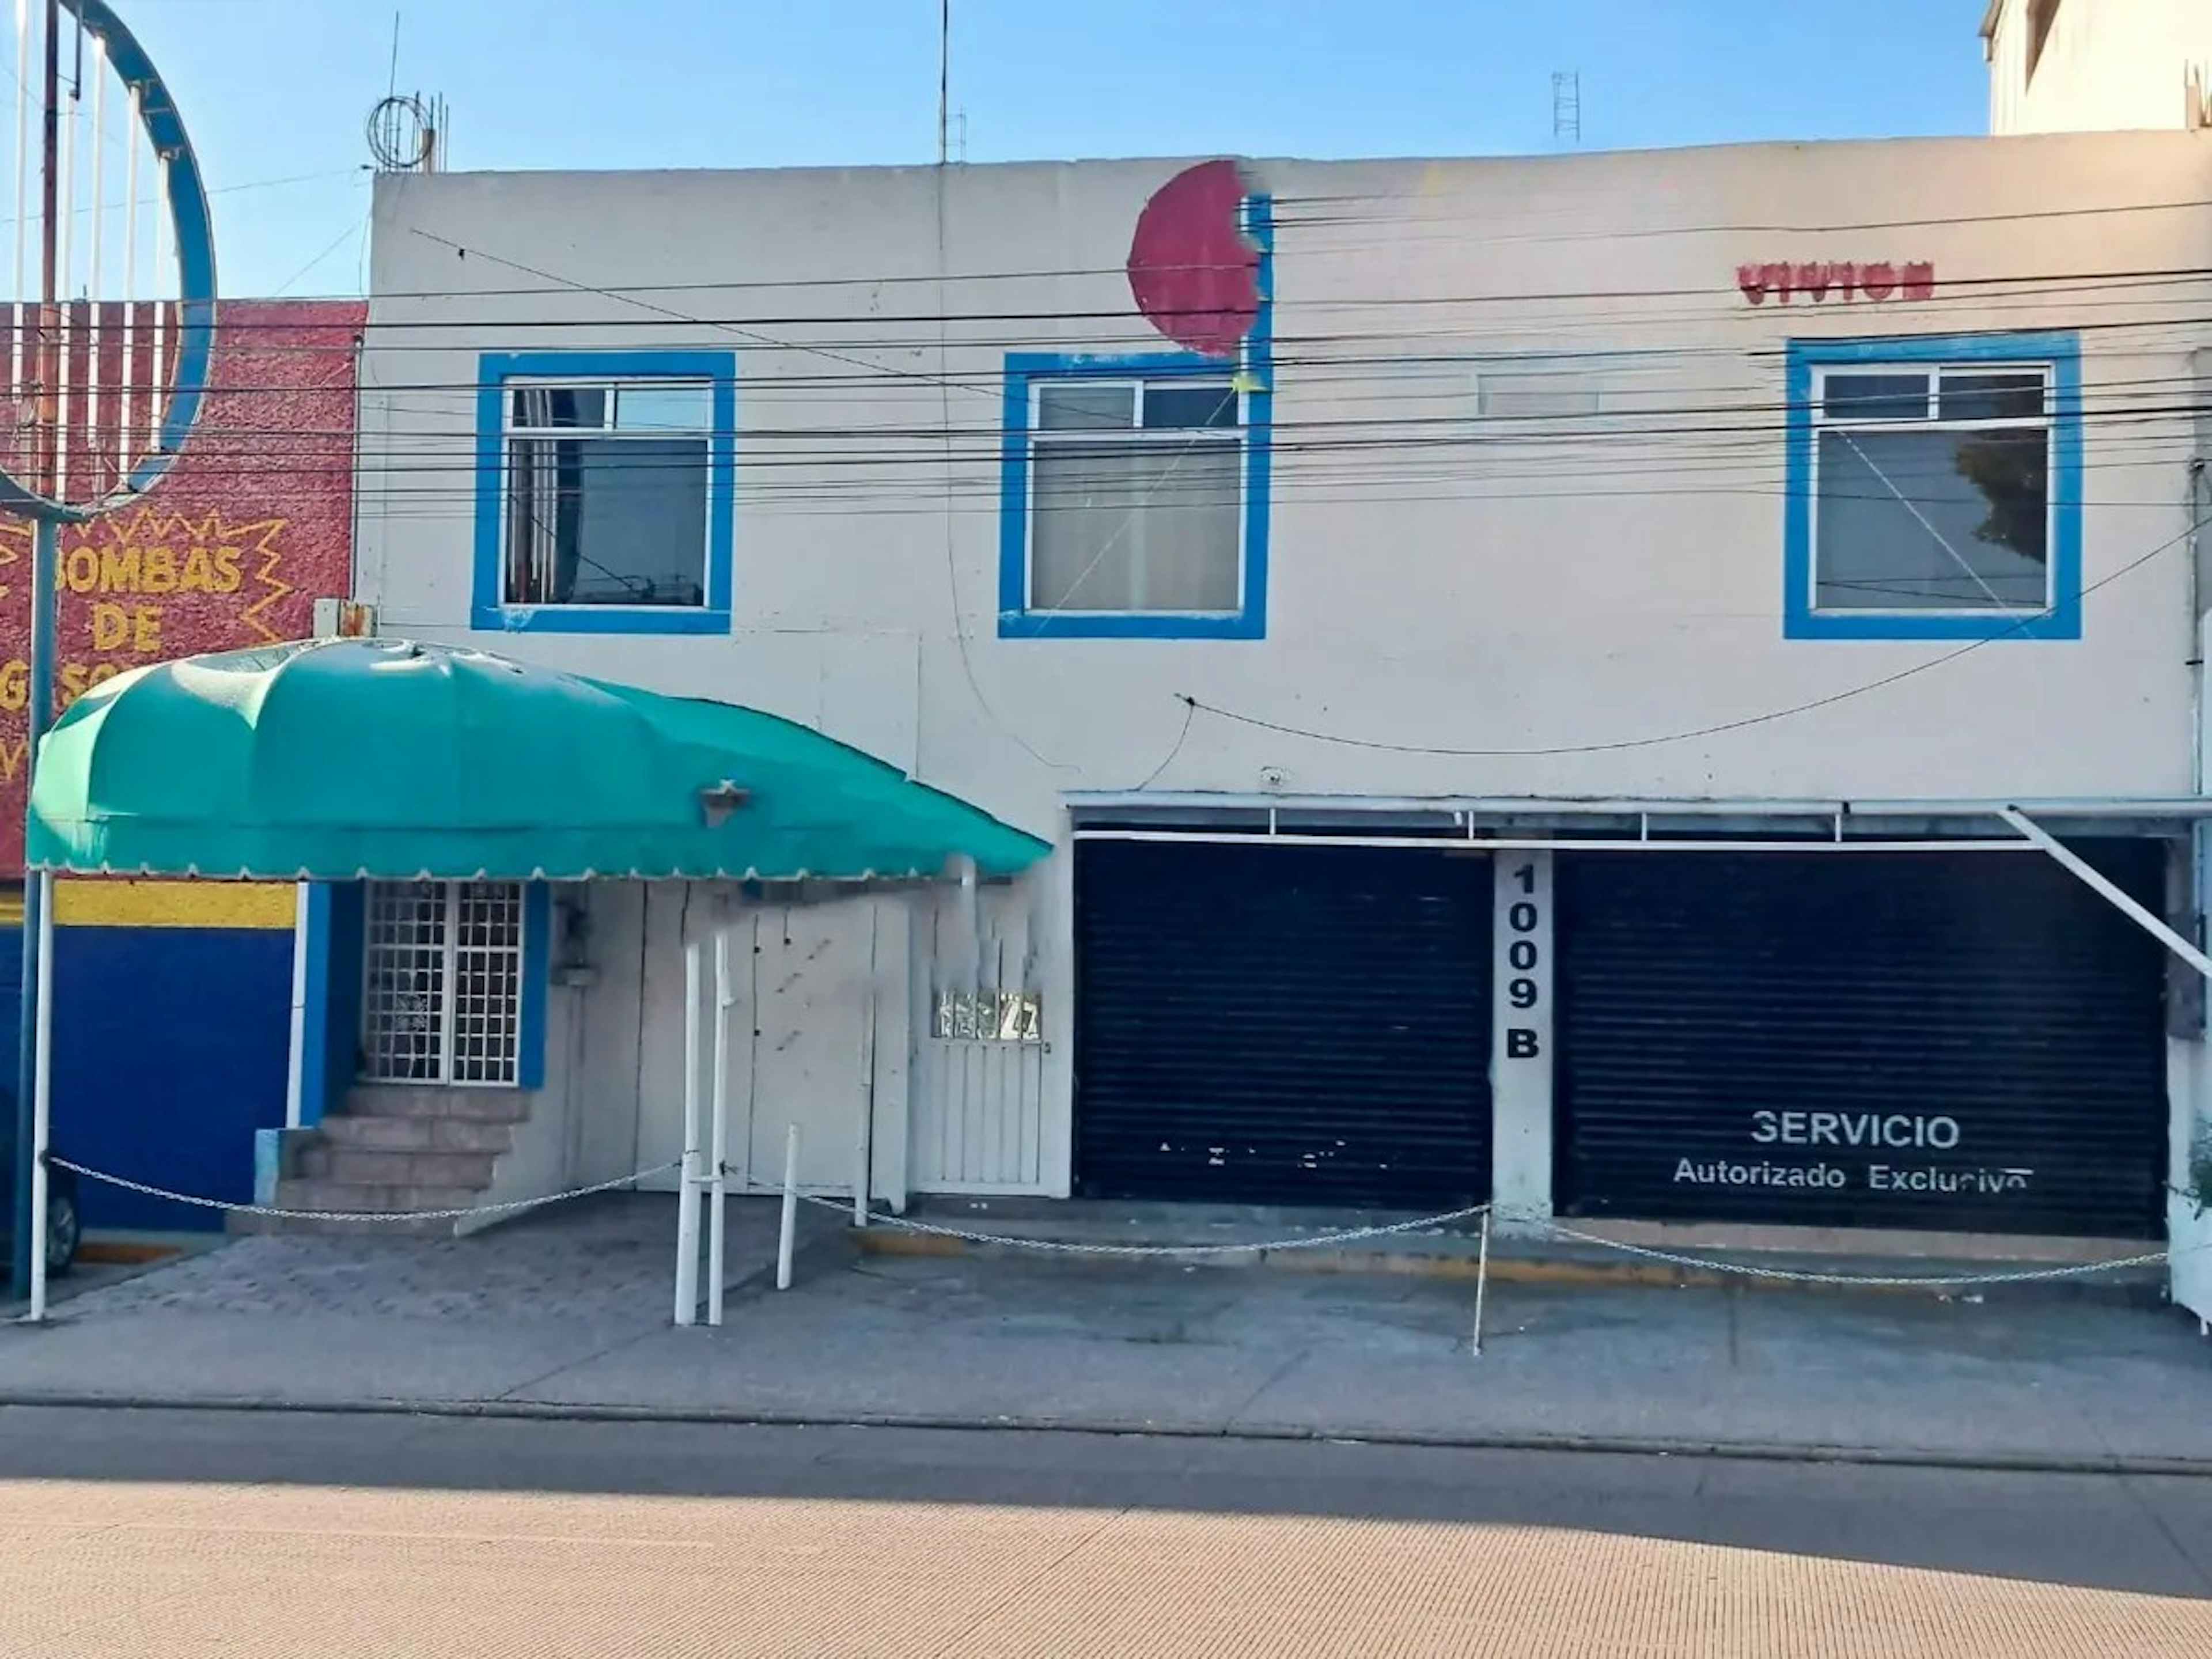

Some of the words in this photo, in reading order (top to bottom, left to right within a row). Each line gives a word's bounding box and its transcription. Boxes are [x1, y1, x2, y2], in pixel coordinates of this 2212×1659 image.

[94, 603, 163, 652] DE
[1509, 864, 1537, 1009] 1009
[1507, 1028, 1539, 1058] B
[1751, 1110, 1960, 1148] SERVICIO
[1673, 1157, 1846, 1188] Autorizado
